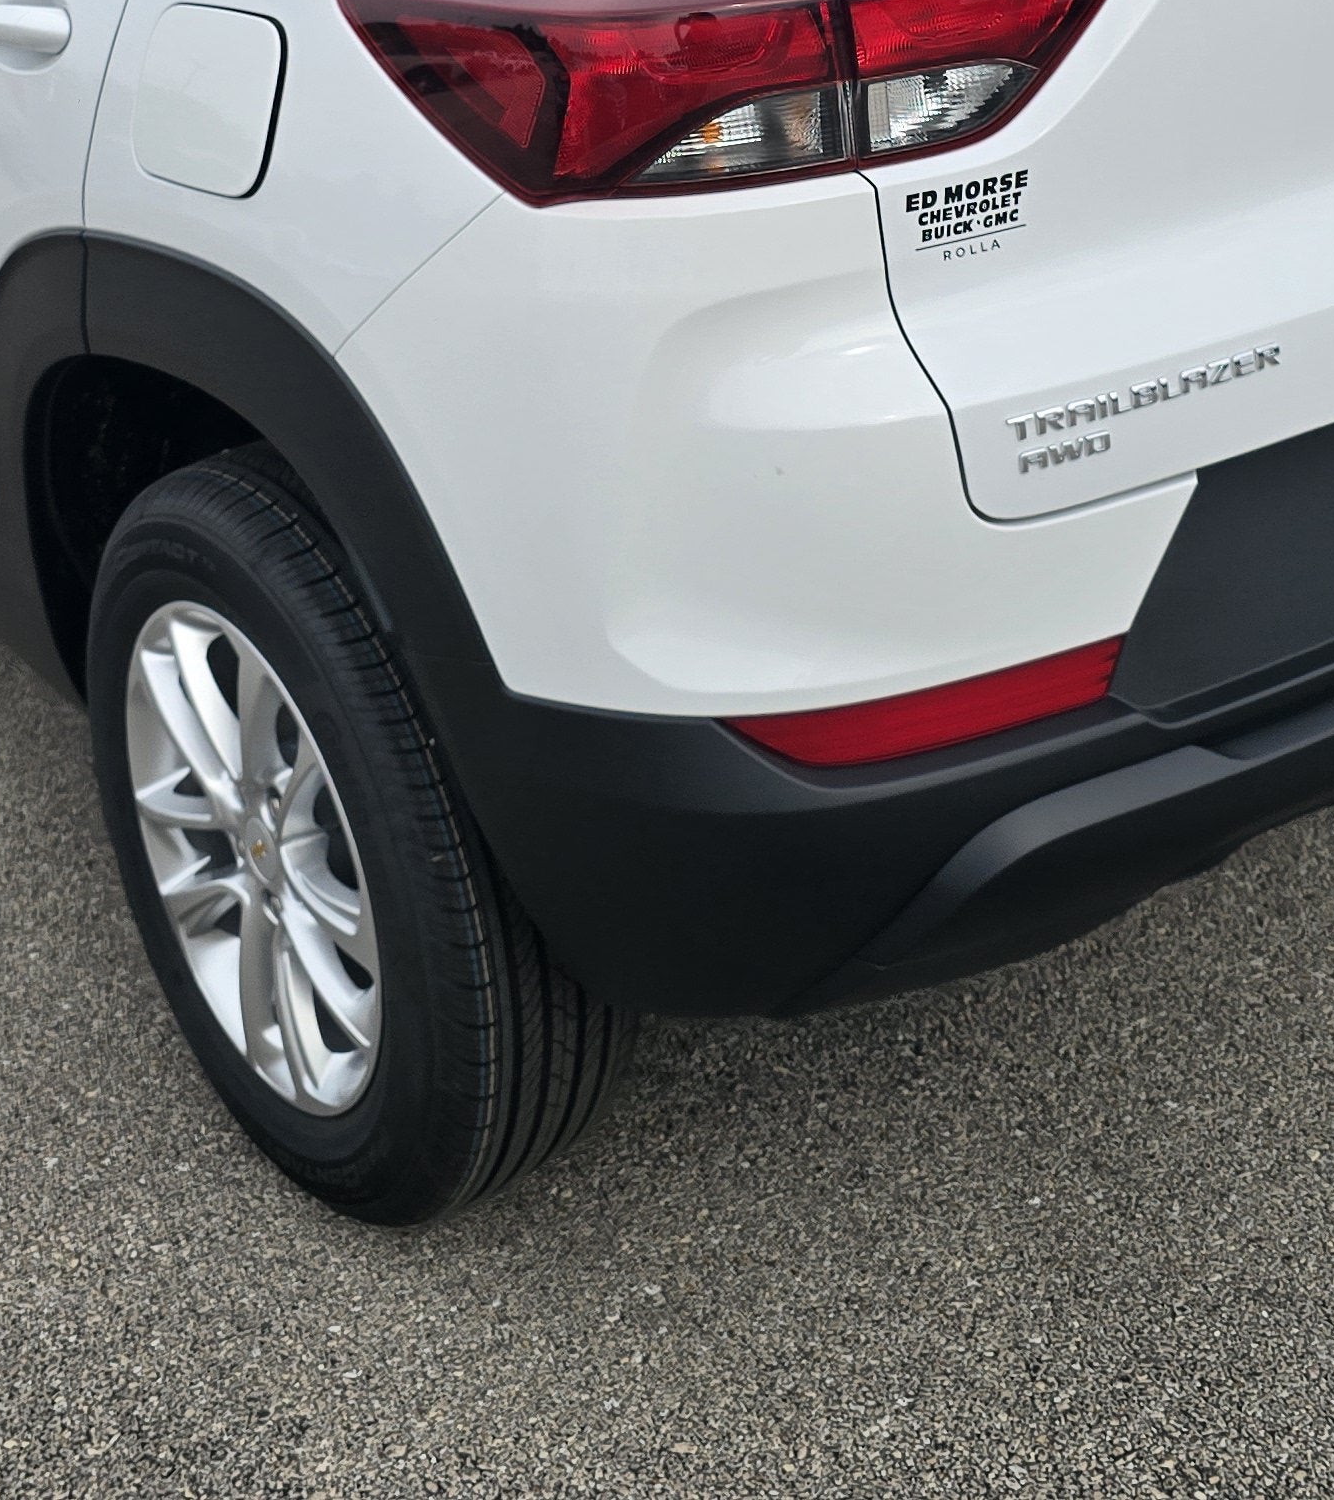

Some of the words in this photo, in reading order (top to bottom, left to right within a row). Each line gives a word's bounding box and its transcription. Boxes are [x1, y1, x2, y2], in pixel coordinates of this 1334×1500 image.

[905, 189, 938, 213] ED
[944, 168, 1029, 205] MORSE
[917, 190, 1022, 227] CHEVROLET
[942, 238, 1002, 261] ROLLA
[1004, 341, 1282, 442] TRAILBLAZER
[1018, 429, 1113, 474] AWD
